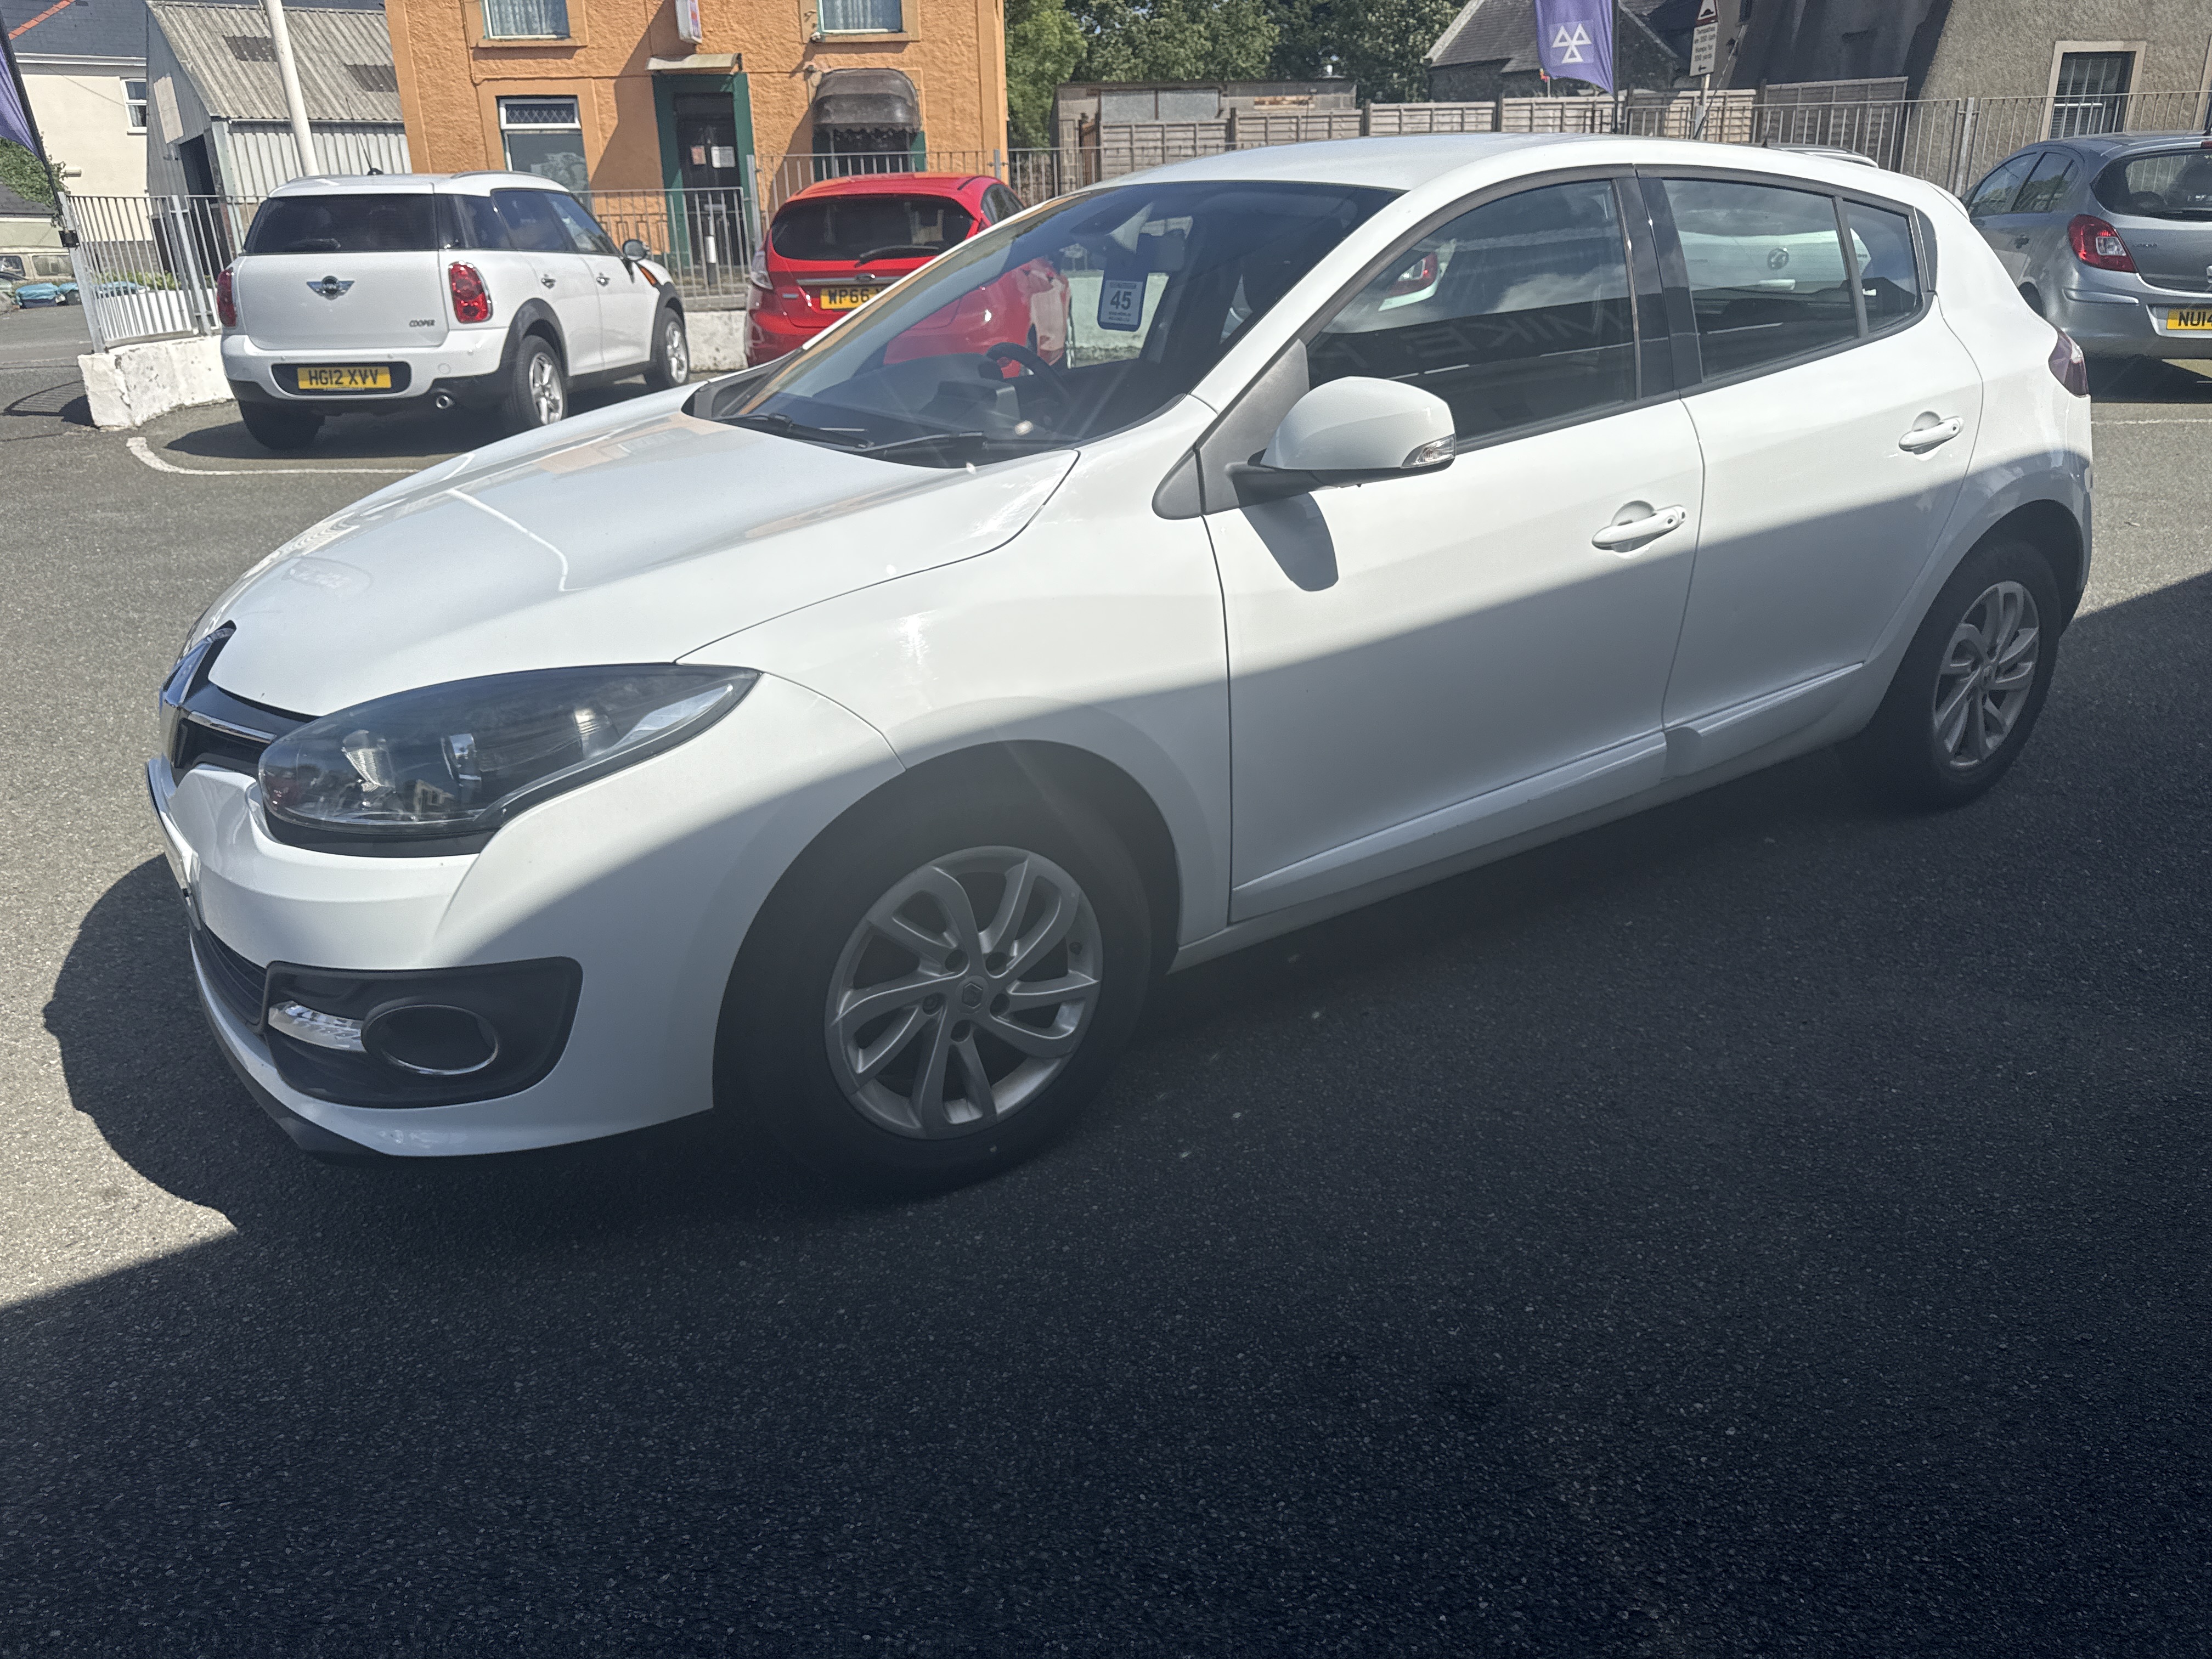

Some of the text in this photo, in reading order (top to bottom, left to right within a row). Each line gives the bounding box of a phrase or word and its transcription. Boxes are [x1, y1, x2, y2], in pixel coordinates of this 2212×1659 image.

[828, 288, 870, 304] WP66
[1110, 290, 1132, 310] 45
[409, 319, 435, 328] COOPER
[308, 368, 378, 386] HG12 XVV
